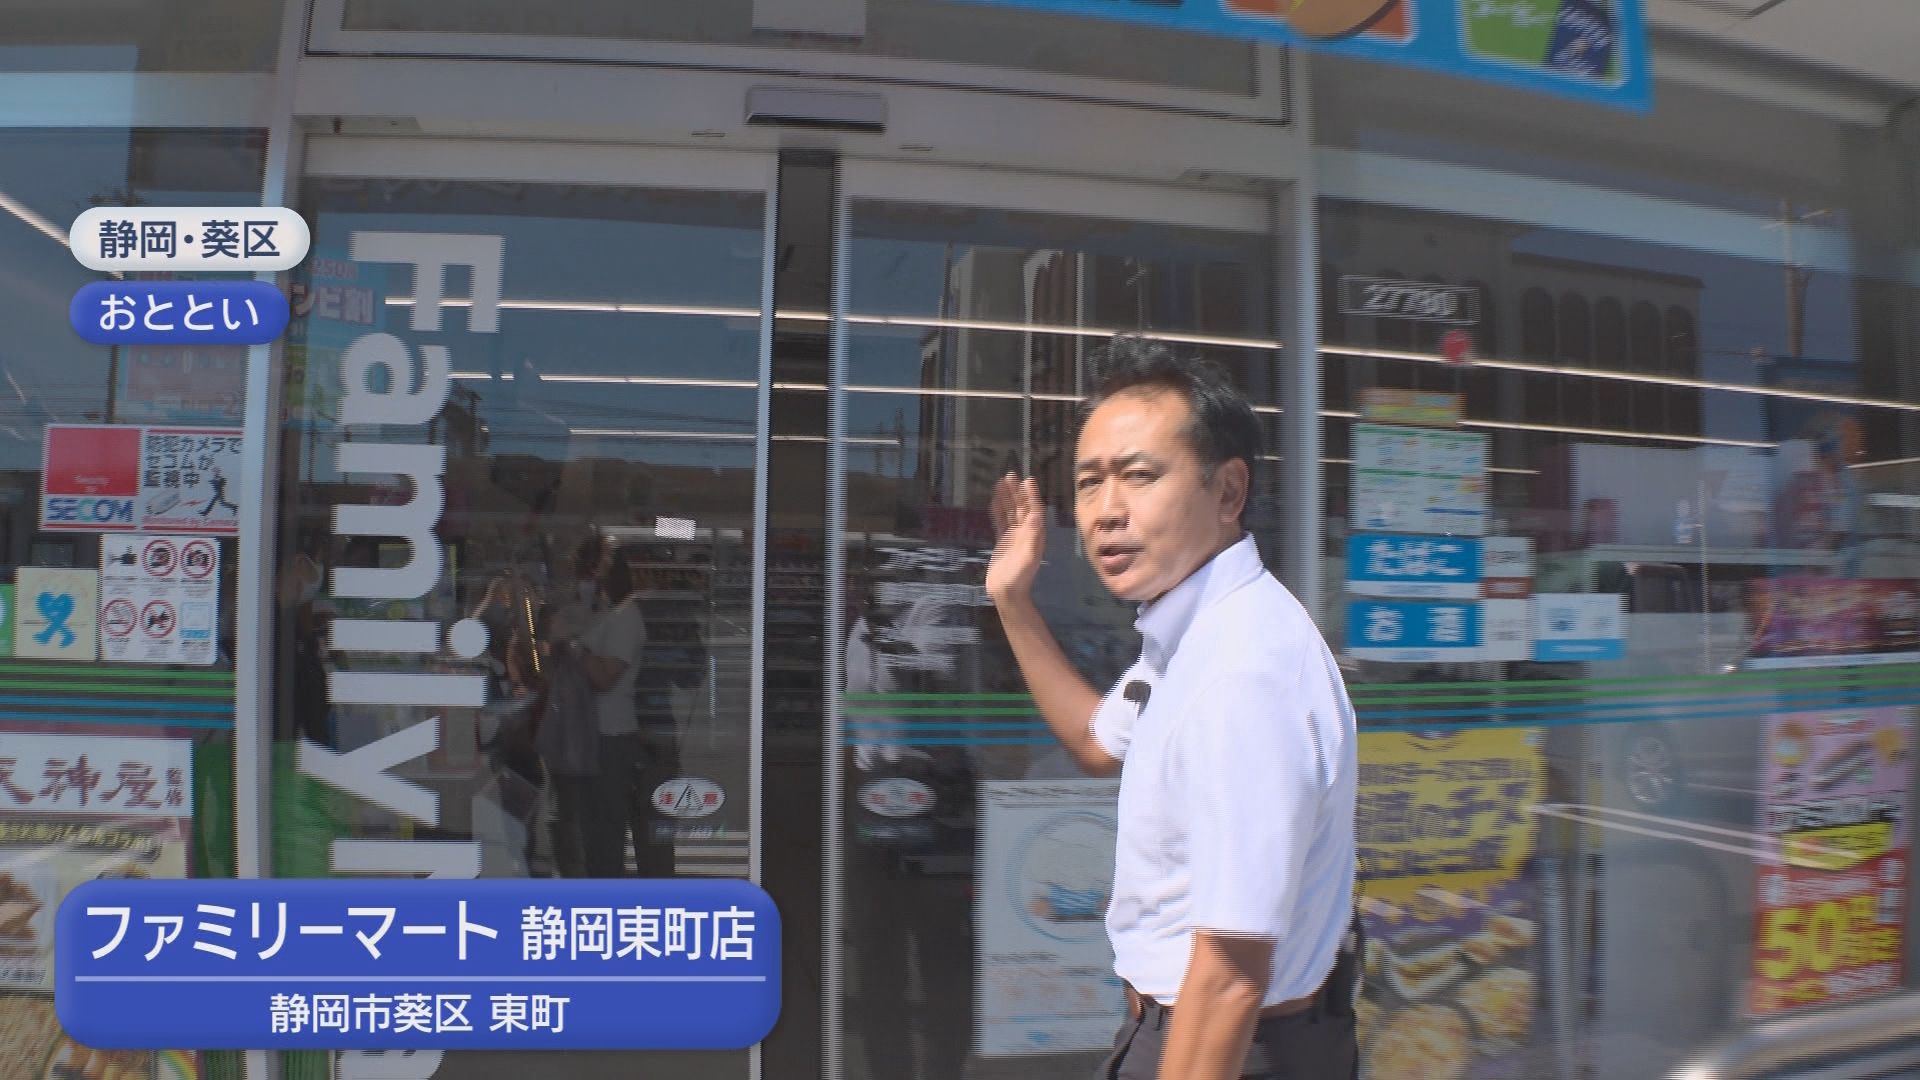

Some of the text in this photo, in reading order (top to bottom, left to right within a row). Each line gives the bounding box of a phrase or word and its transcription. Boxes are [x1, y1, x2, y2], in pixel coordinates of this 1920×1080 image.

[1362, 285, 1457, 319] 27780
[146, 435, 243, 454] 防犯カメラで
[145, 454, 215, 471] セコムが
[143, 470, 201, 488] 監視中
[47, 497, 135, 523] SECOM
[1364, 539, 1465, 576] たばこ
[1364, 604, 1466, 642] お酒
[298, 230, 503, 1080] Family
